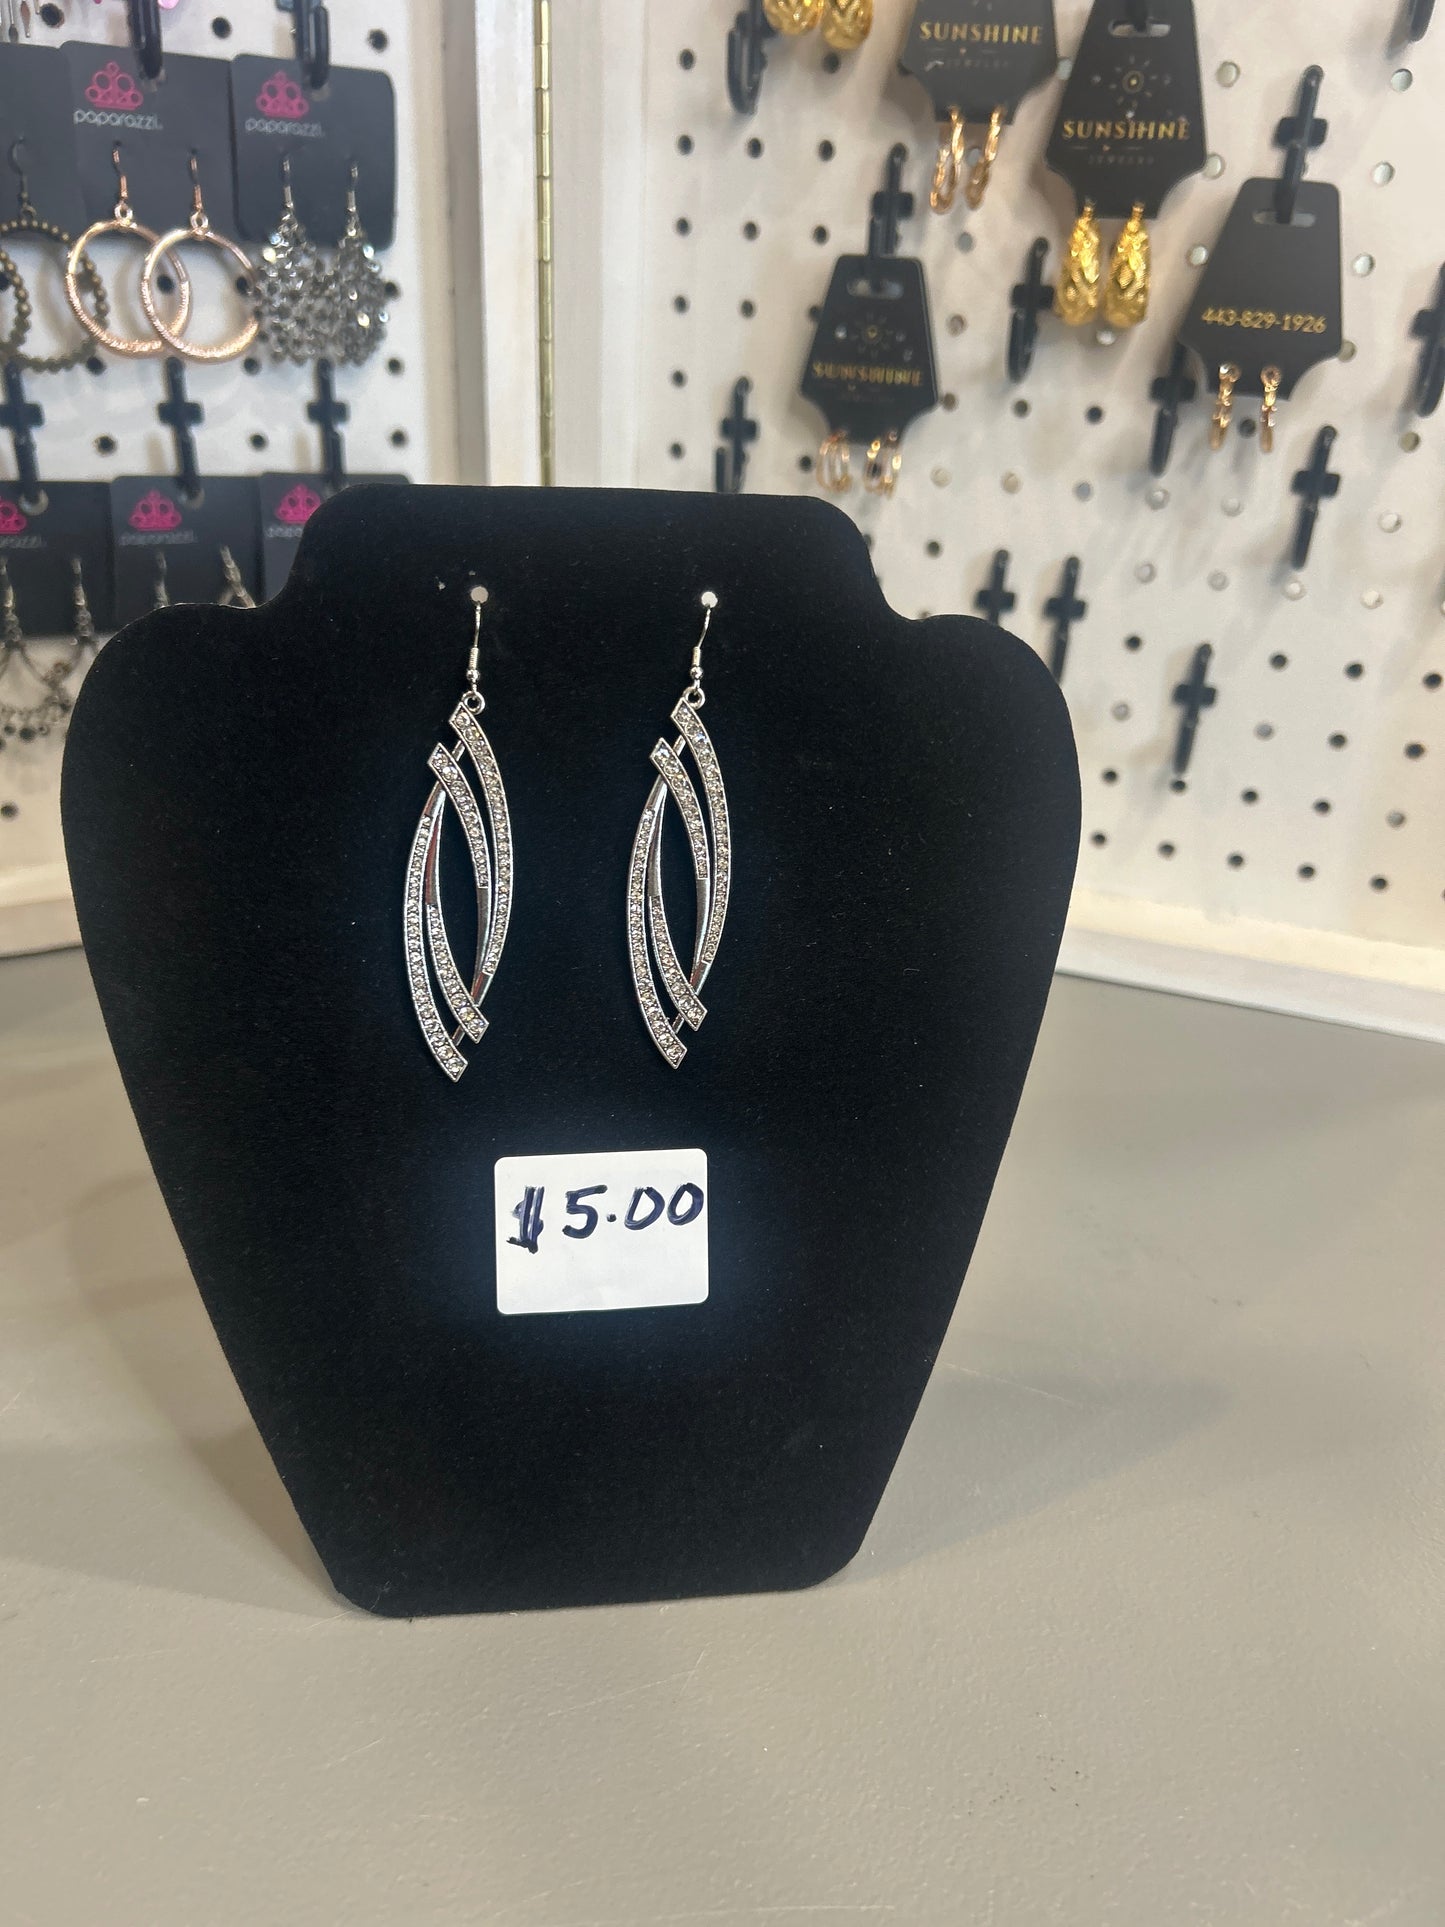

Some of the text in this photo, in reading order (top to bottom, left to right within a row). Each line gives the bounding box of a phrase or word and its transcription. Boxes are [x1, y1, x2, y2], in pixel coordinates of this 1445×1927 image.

[919, 21, 1042, 45] SUNSHINE
[1062, 118, 1191, 141] SUNSHINE
[1201, 307, 1328, 334] 443-829-1926
